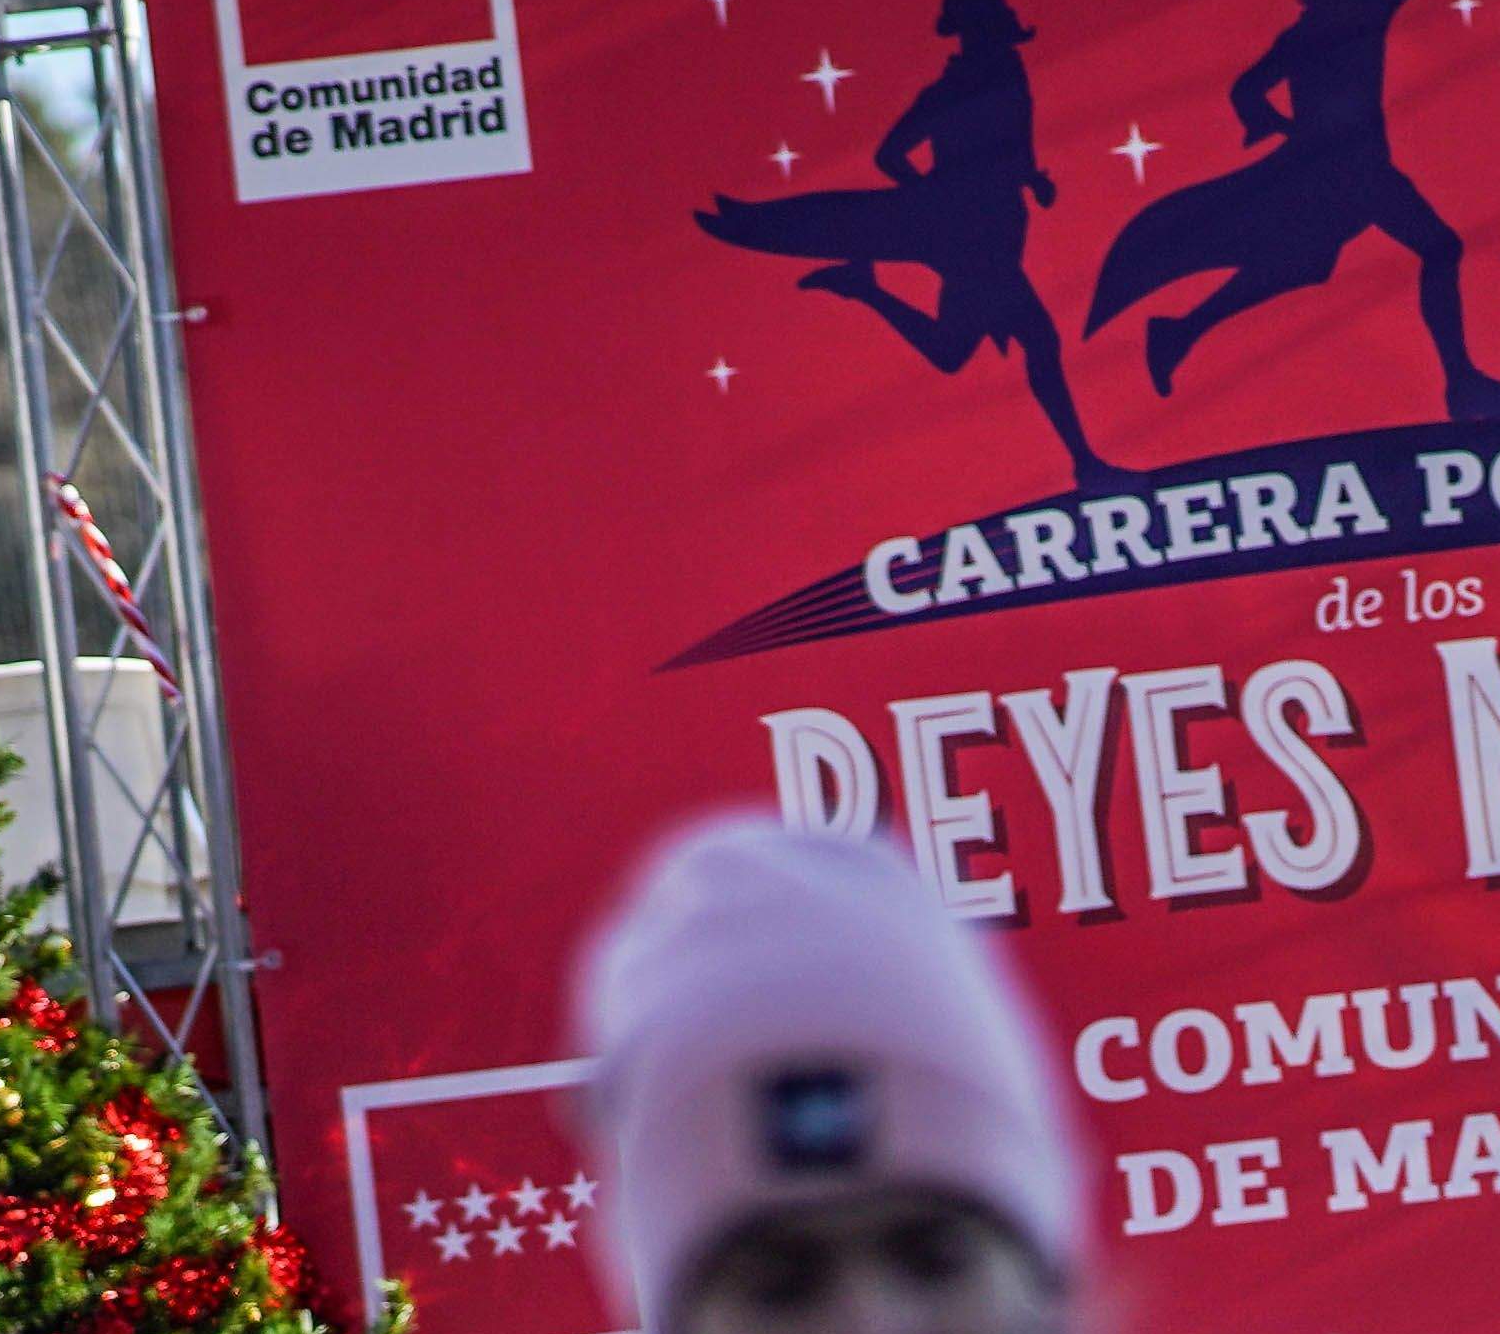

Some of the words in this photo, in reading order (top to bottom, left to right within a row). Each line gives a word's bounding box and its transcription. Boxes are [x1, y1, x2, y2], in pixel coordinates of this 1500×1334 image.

[245, 56, 504, 116] Comunidad
[250, 120, 313, 160] de
[330, 96, 507, 152] Madrid
[863, 461, 1389, 615] CARRERA
[1315, 575, 1384, 633] de
[1400, 568, 1485, 623] los
[1116, 1136, 1290, 1237] DE
